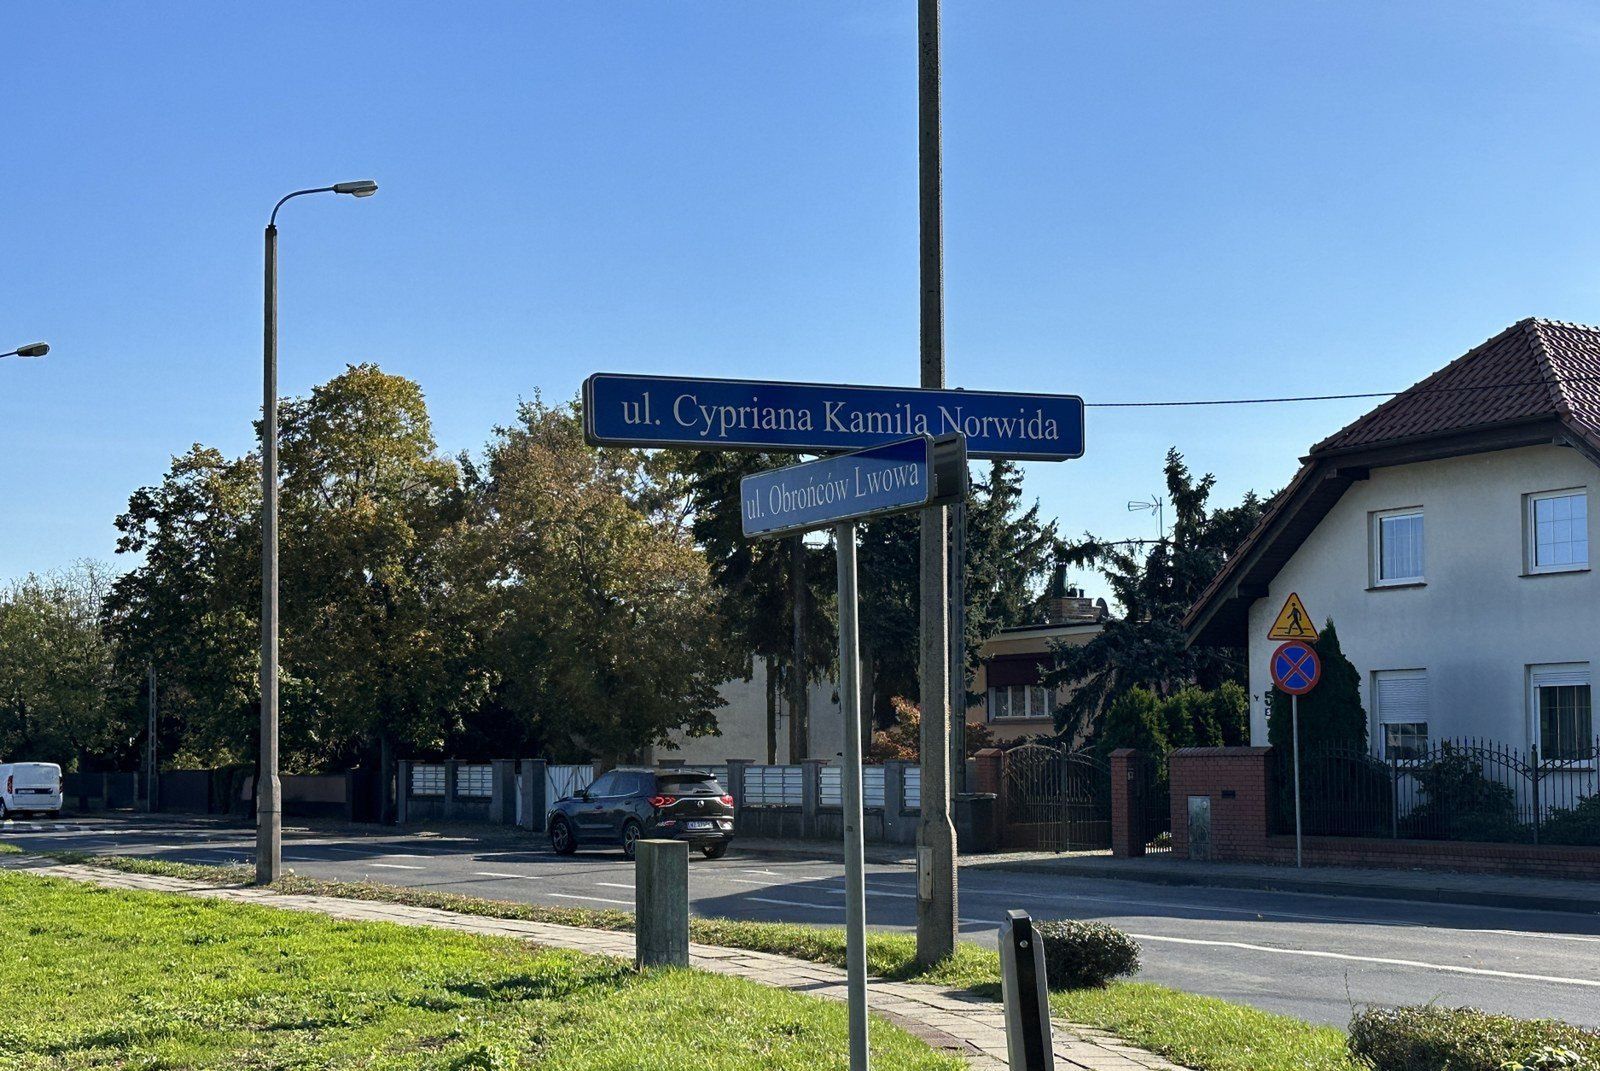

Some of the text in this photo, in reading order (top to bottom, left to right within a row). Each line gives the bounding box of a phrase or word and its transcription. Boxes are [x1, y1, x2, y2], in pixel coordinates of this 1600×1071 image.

[621, 391, 1059, 440] ul. Cypriana Kamila Norwida
[746, 462, 919, 520] ul. Obrońców Lwowa
